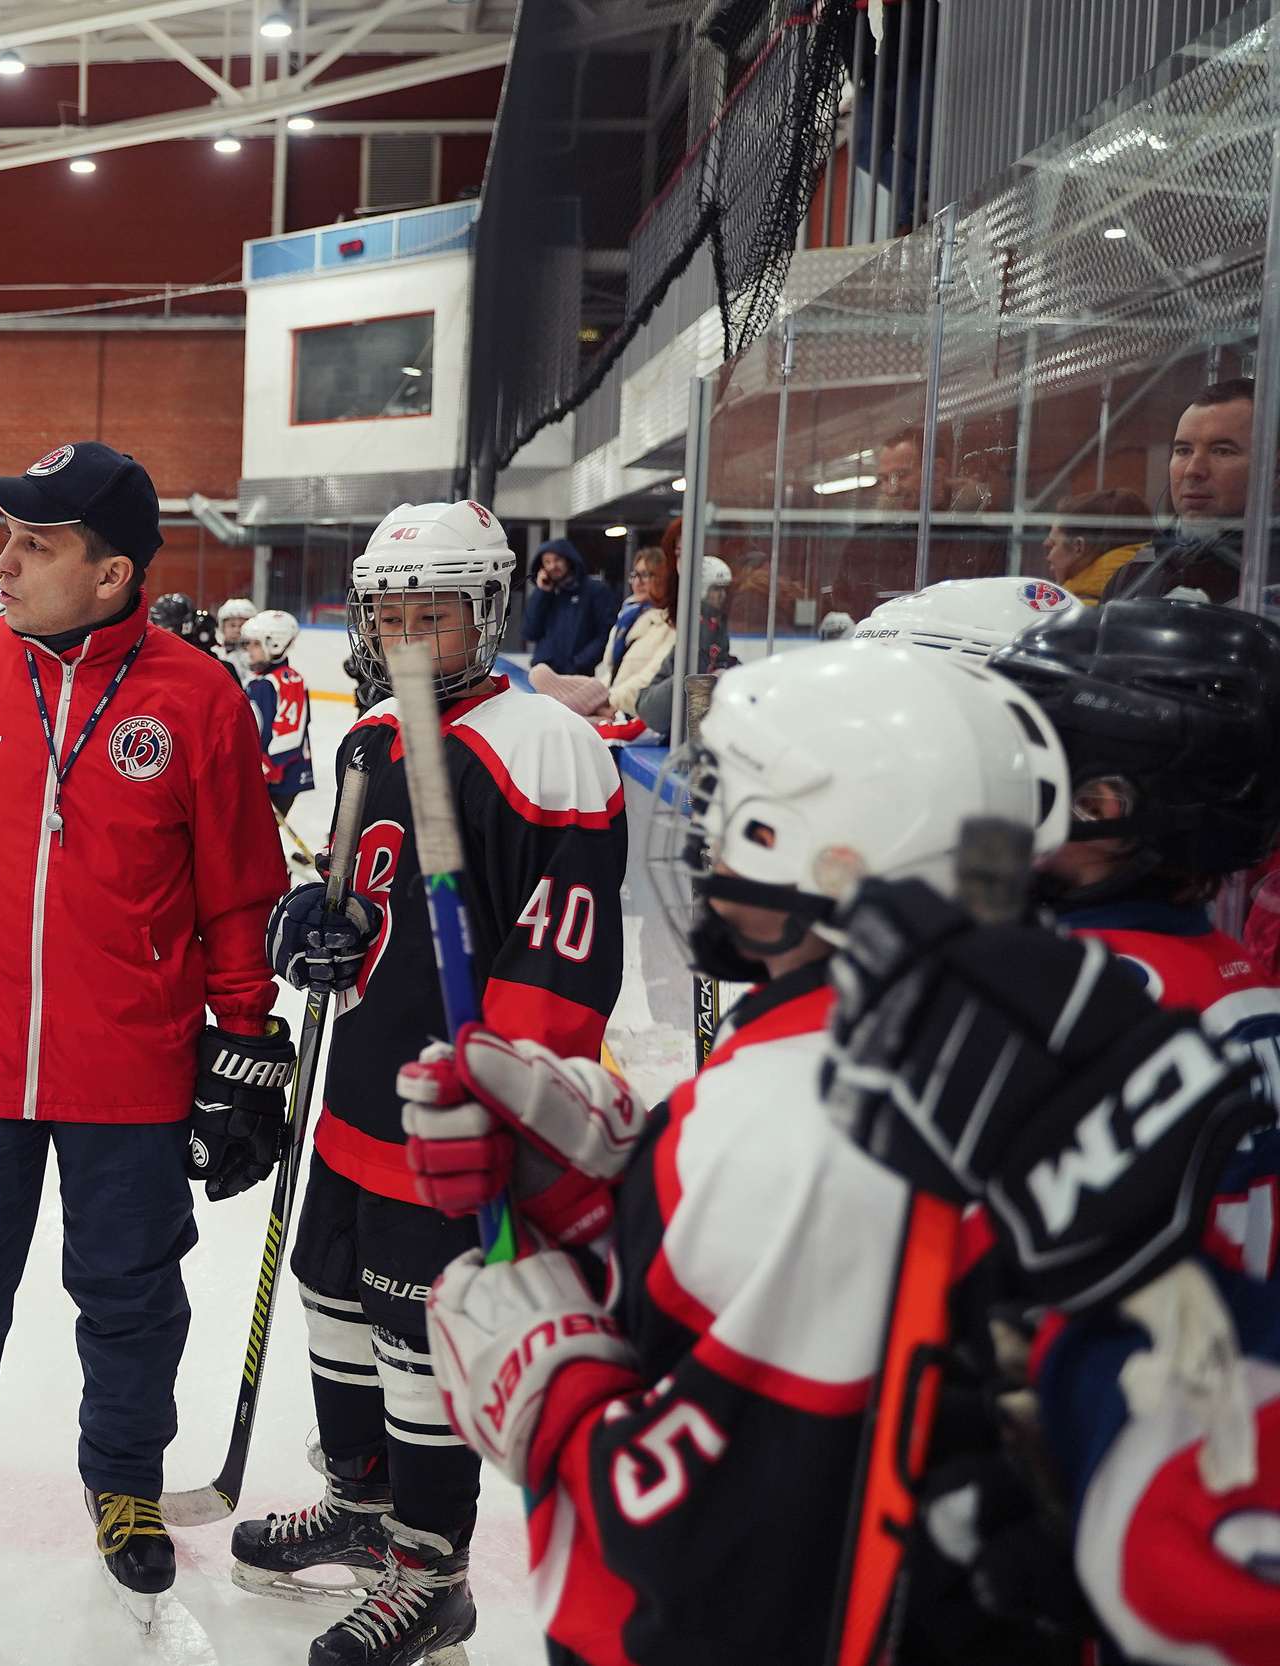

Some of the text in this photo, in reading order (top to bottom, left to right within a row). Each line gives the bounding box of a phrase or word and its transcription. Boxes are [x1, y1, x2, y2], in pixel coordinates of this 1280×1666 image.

[390, 527, 420, 540] 40
[375, 564, 424, 573] BAUER
[855, 629, 900, 639] BAUER
[120, 720, 151, 735] HOCKEY
[150, 724, 167, 742] CLUB
[154, 744, 168, 768] VIKHR
[515, 875, 595, 963] 40
[361, 1267, 433, 1302] BAUE
[242, 1210, 283, 1387] WARRIOR
